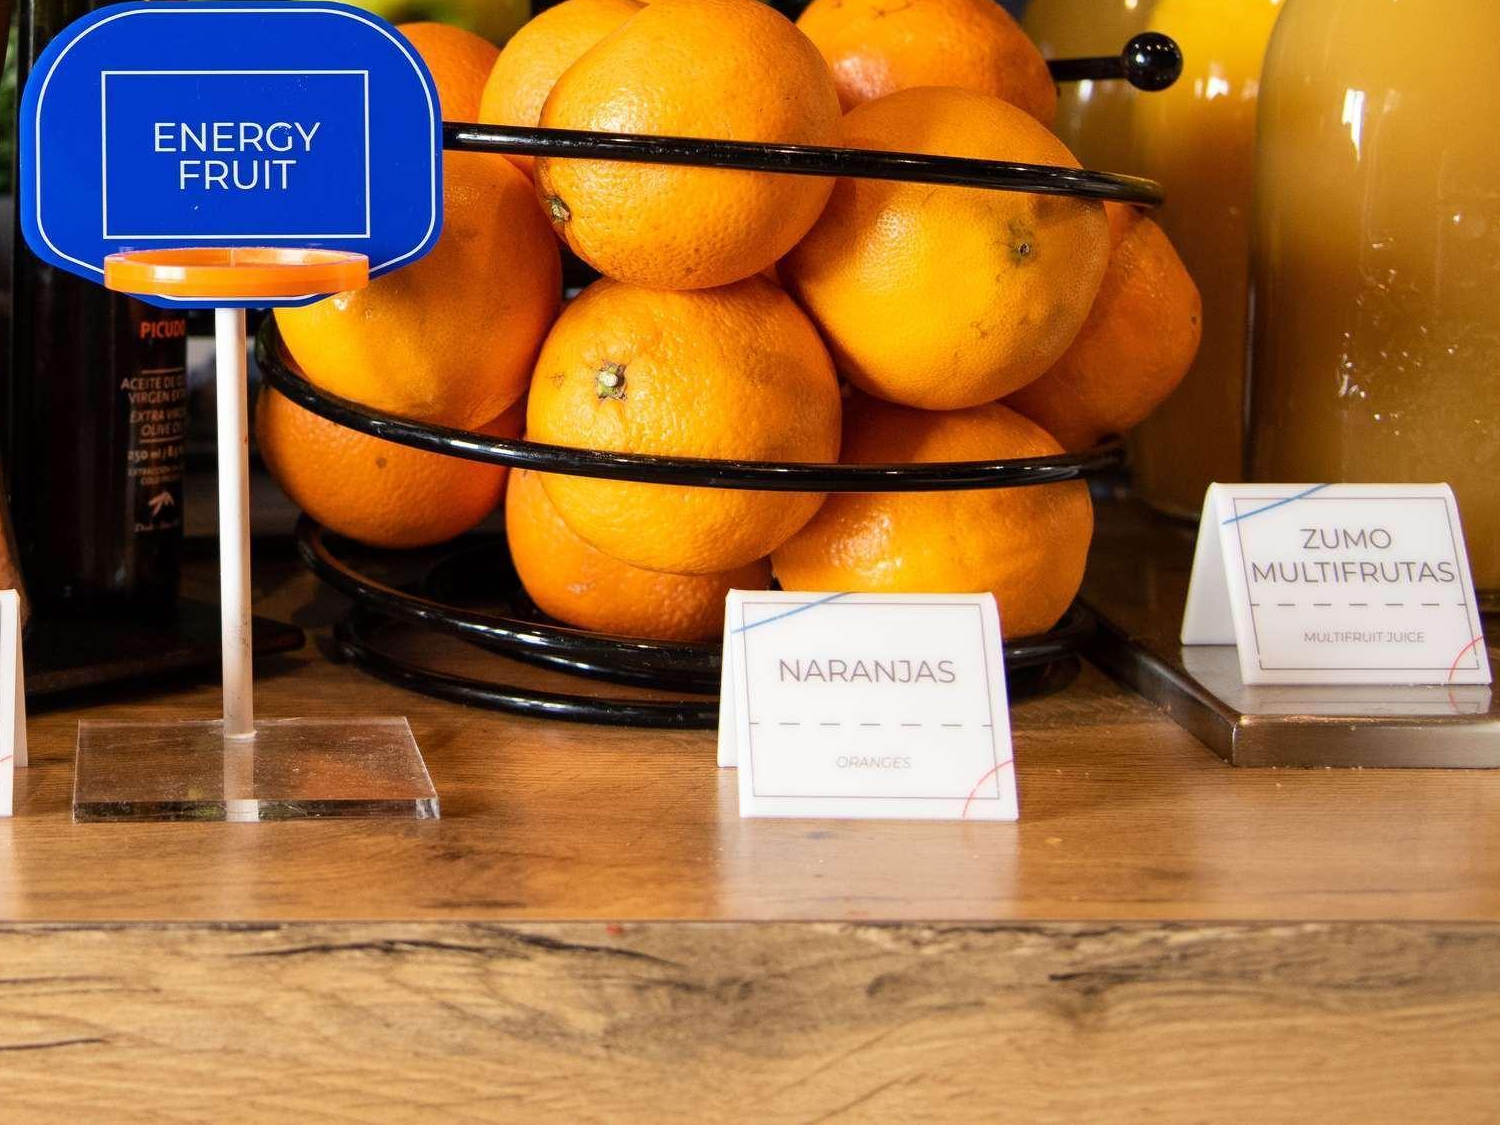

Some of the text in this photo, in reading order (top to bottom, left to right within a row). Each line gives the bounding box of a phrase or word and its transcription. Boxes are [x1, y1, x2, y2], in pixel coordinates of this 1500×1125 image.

[153, 121, 321, 152] ENERGY
[179, 159, 297, 190] FRUIT
[120, 376, 163, 390] ACEITE
[1299, 528, 1392, 550] ZUMO
[1251, 561, 1456, 584] MULTIFRUTAS
[1303, 631, 1426, 644] MULTIFRUIT JUICE
[779, 658, 957, 684] NARANJAS
[836, 756, 912, 769] ORANGES
